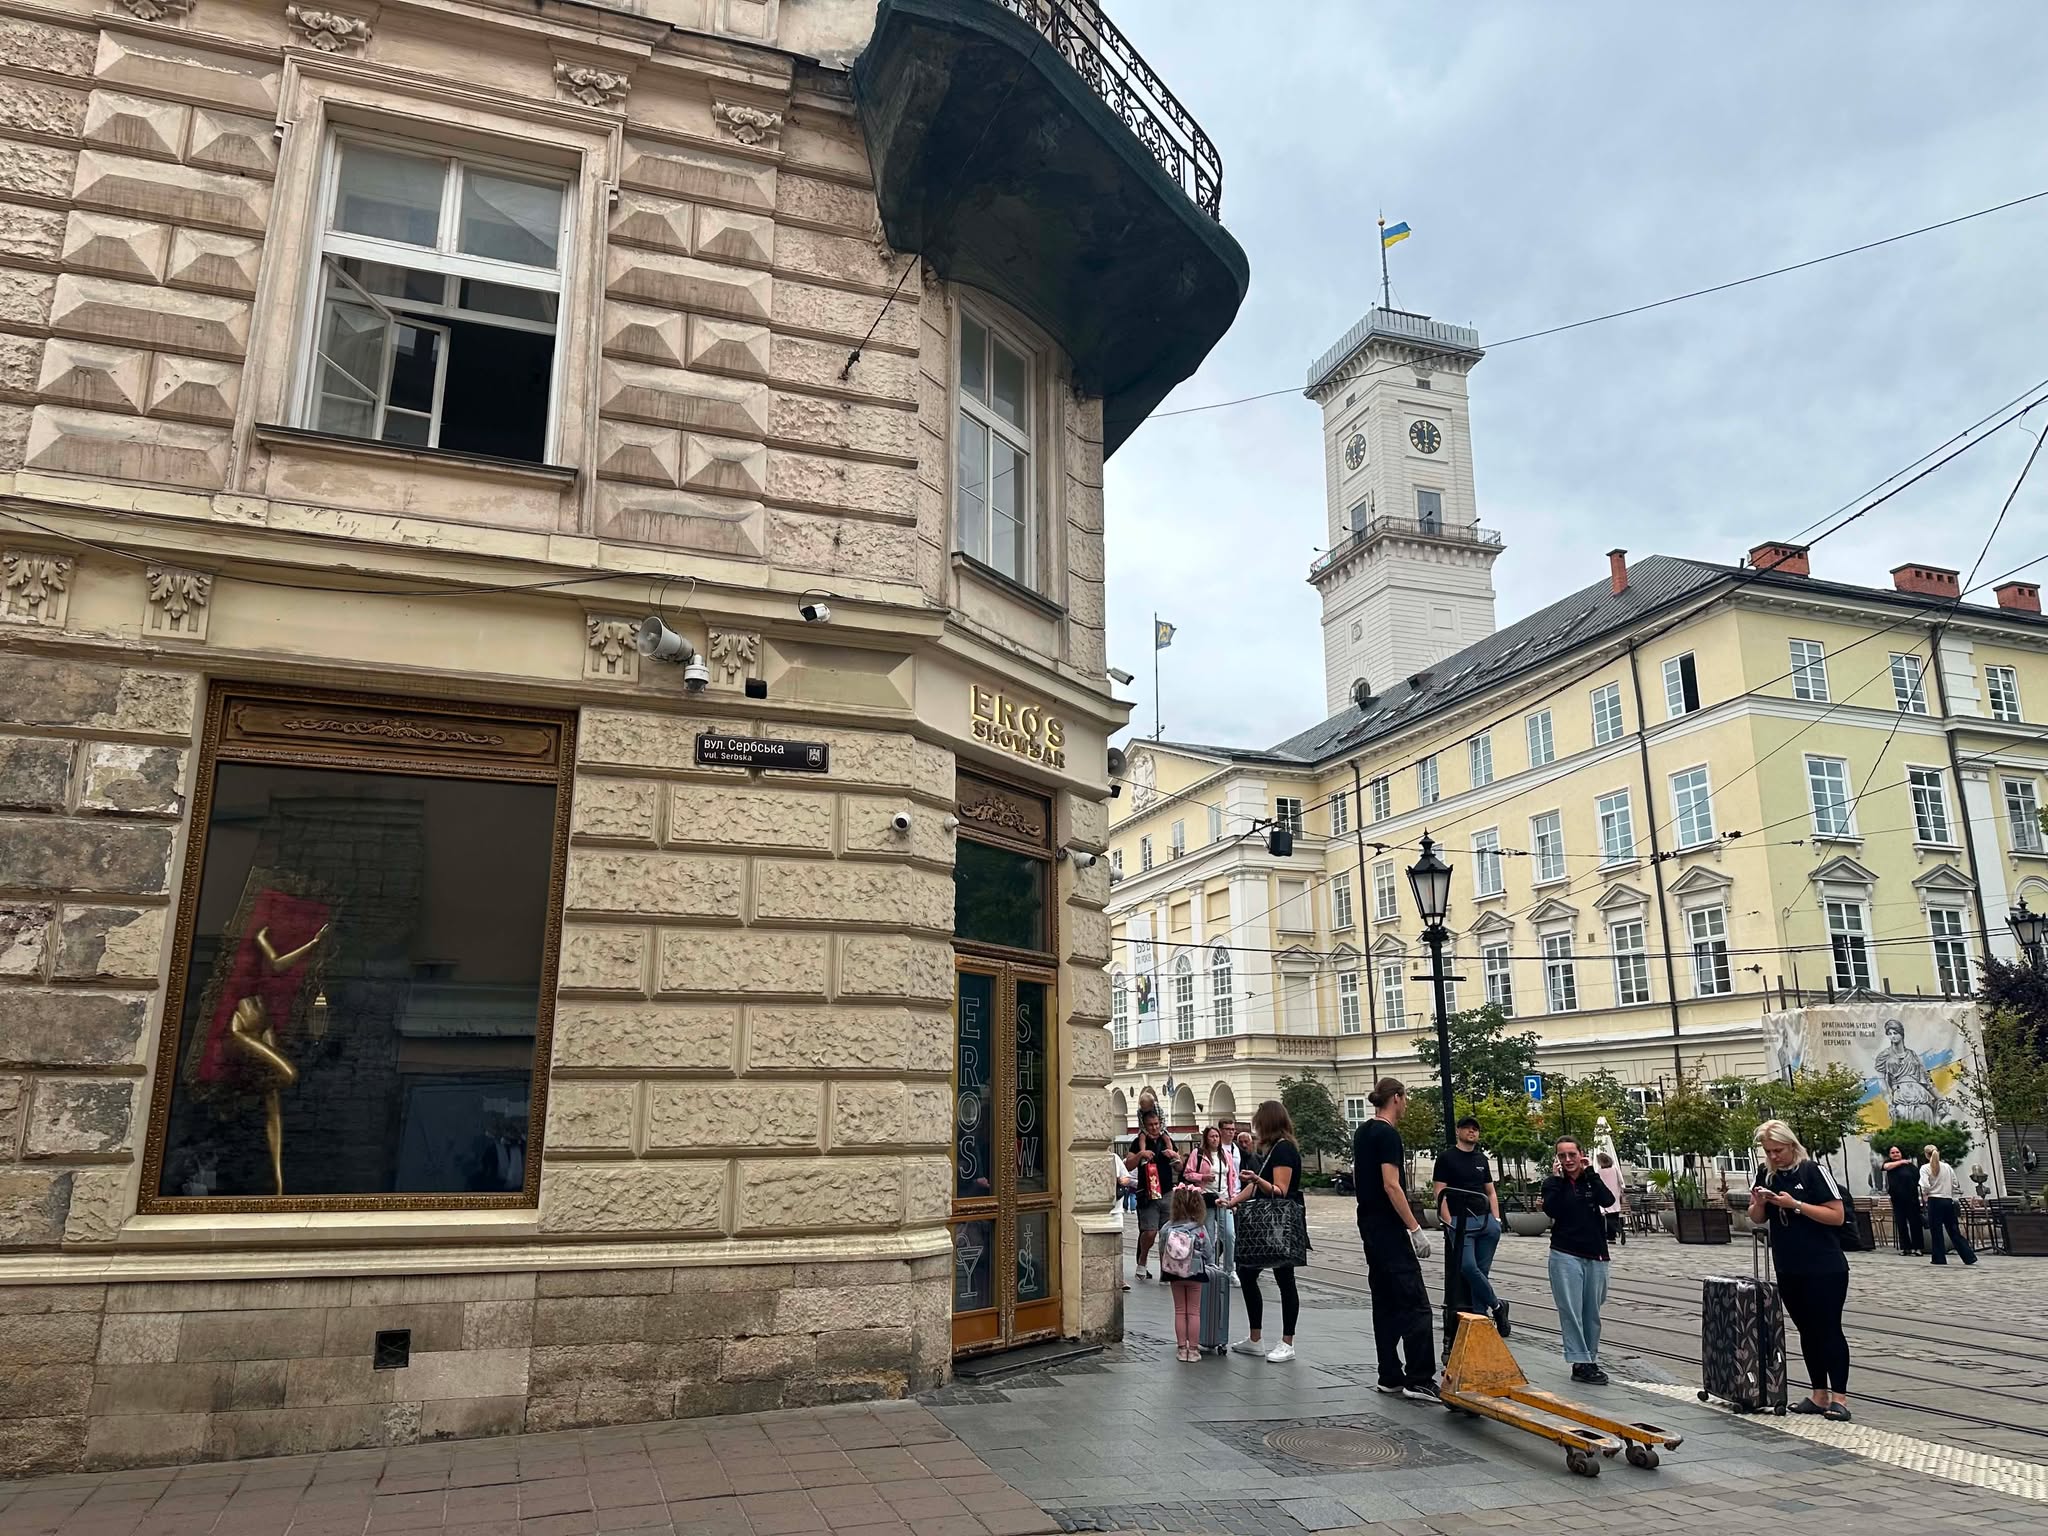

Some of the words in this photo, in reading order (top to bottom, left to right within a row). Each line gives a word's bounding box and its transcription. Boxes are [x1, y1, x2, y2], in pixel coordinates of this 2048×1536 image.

[971, 685, 1065, 749] EROS
[704, 739, 725, 751] вул.
[728, 739, 784, 755] Сербська
[704, 751, 718, 760] vul.
[721, 752, 752, 762] Serbska
[957, 996, 982, 1180] EROS
[1016, 1003, 1039, 1178] SHOW
[1528, 1079, 1537, 1097] P
